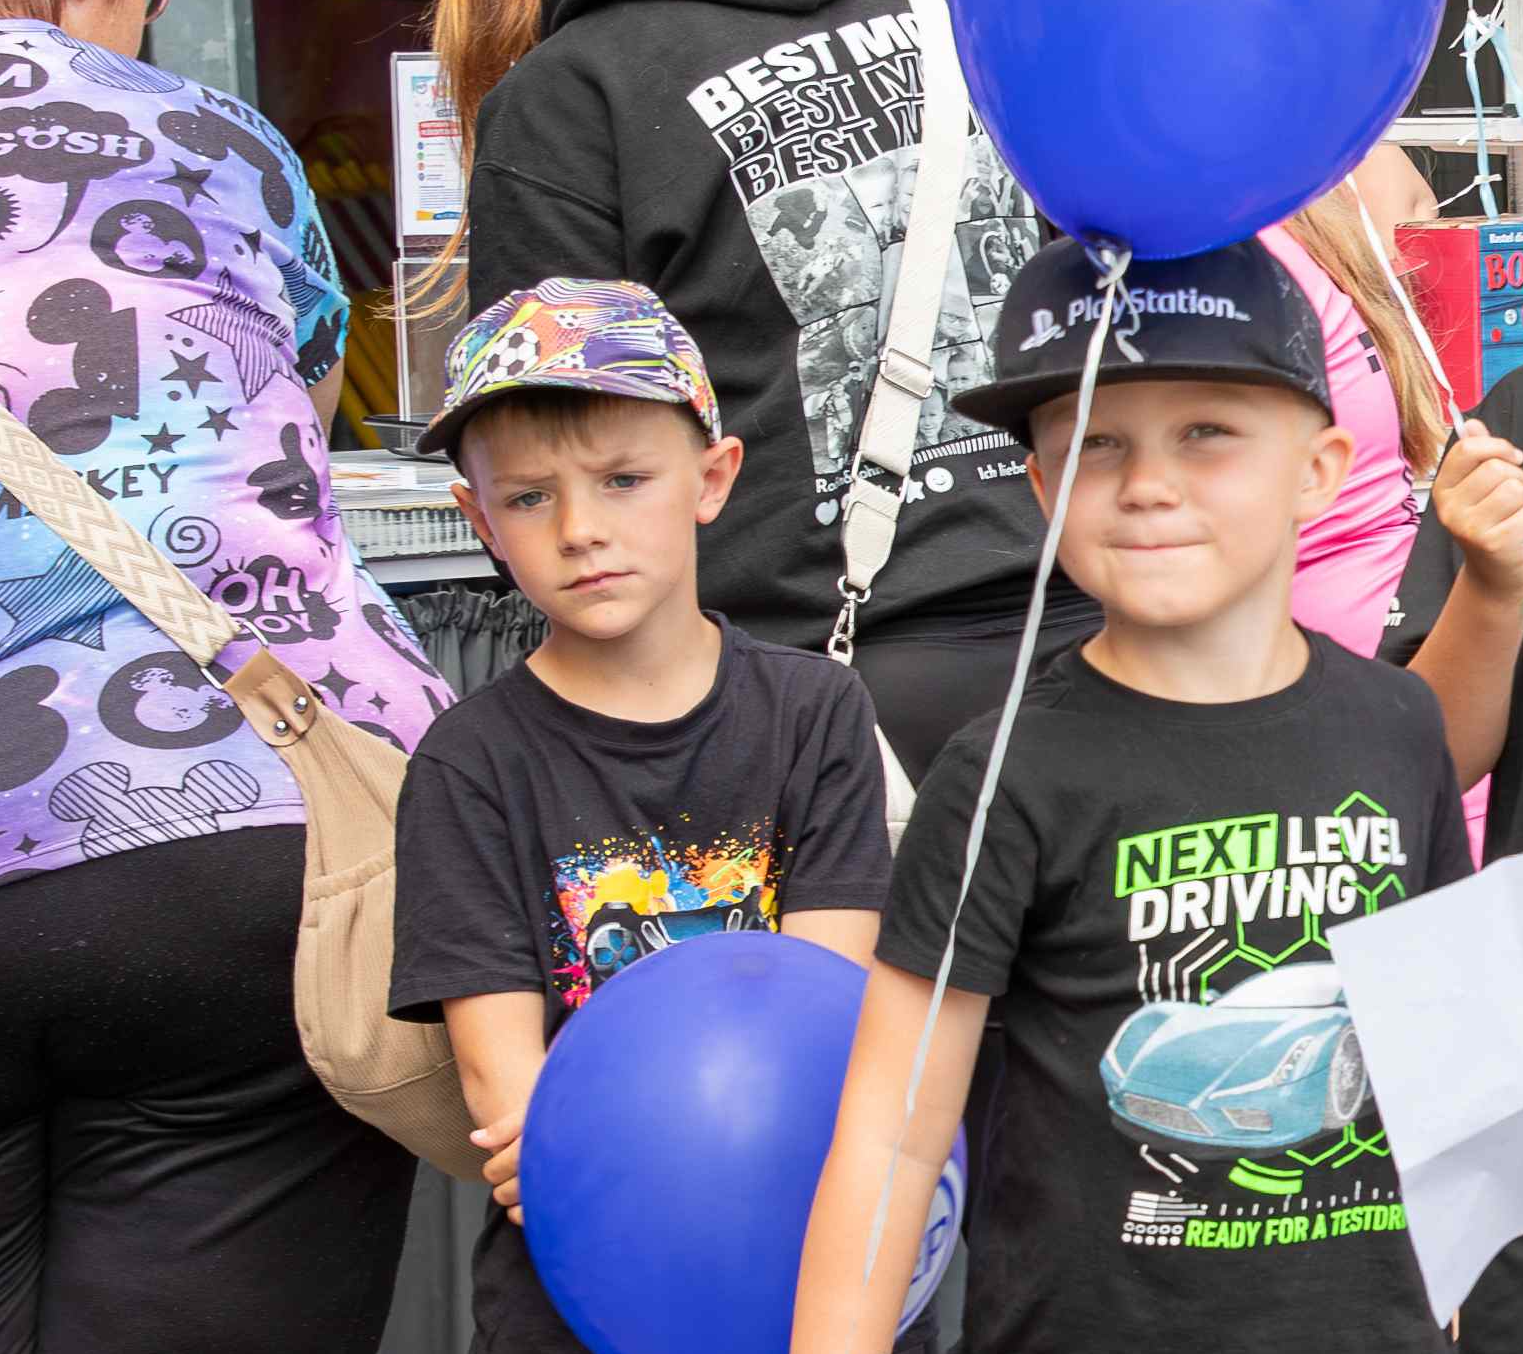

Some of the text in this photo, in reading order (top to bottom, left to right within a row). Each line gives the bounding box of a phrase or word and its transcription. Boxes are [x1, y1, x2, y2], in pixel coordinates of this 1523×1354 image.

[686, 31, 839, 130] BEST
[711, 73, 863, 168] BEST
[729, 117, 887, 208] BEST
[209, 566, 307, 615] OH
[1125, 815, 1408, 891] NEXT LEVEL
[1128, 865, 1359, 941] DRIVING
[1185, 1223, 1260, 1249] READY
[1264, 1216, 1310, 1245] FOR
[1311, 1214, 1327, 1238] A
